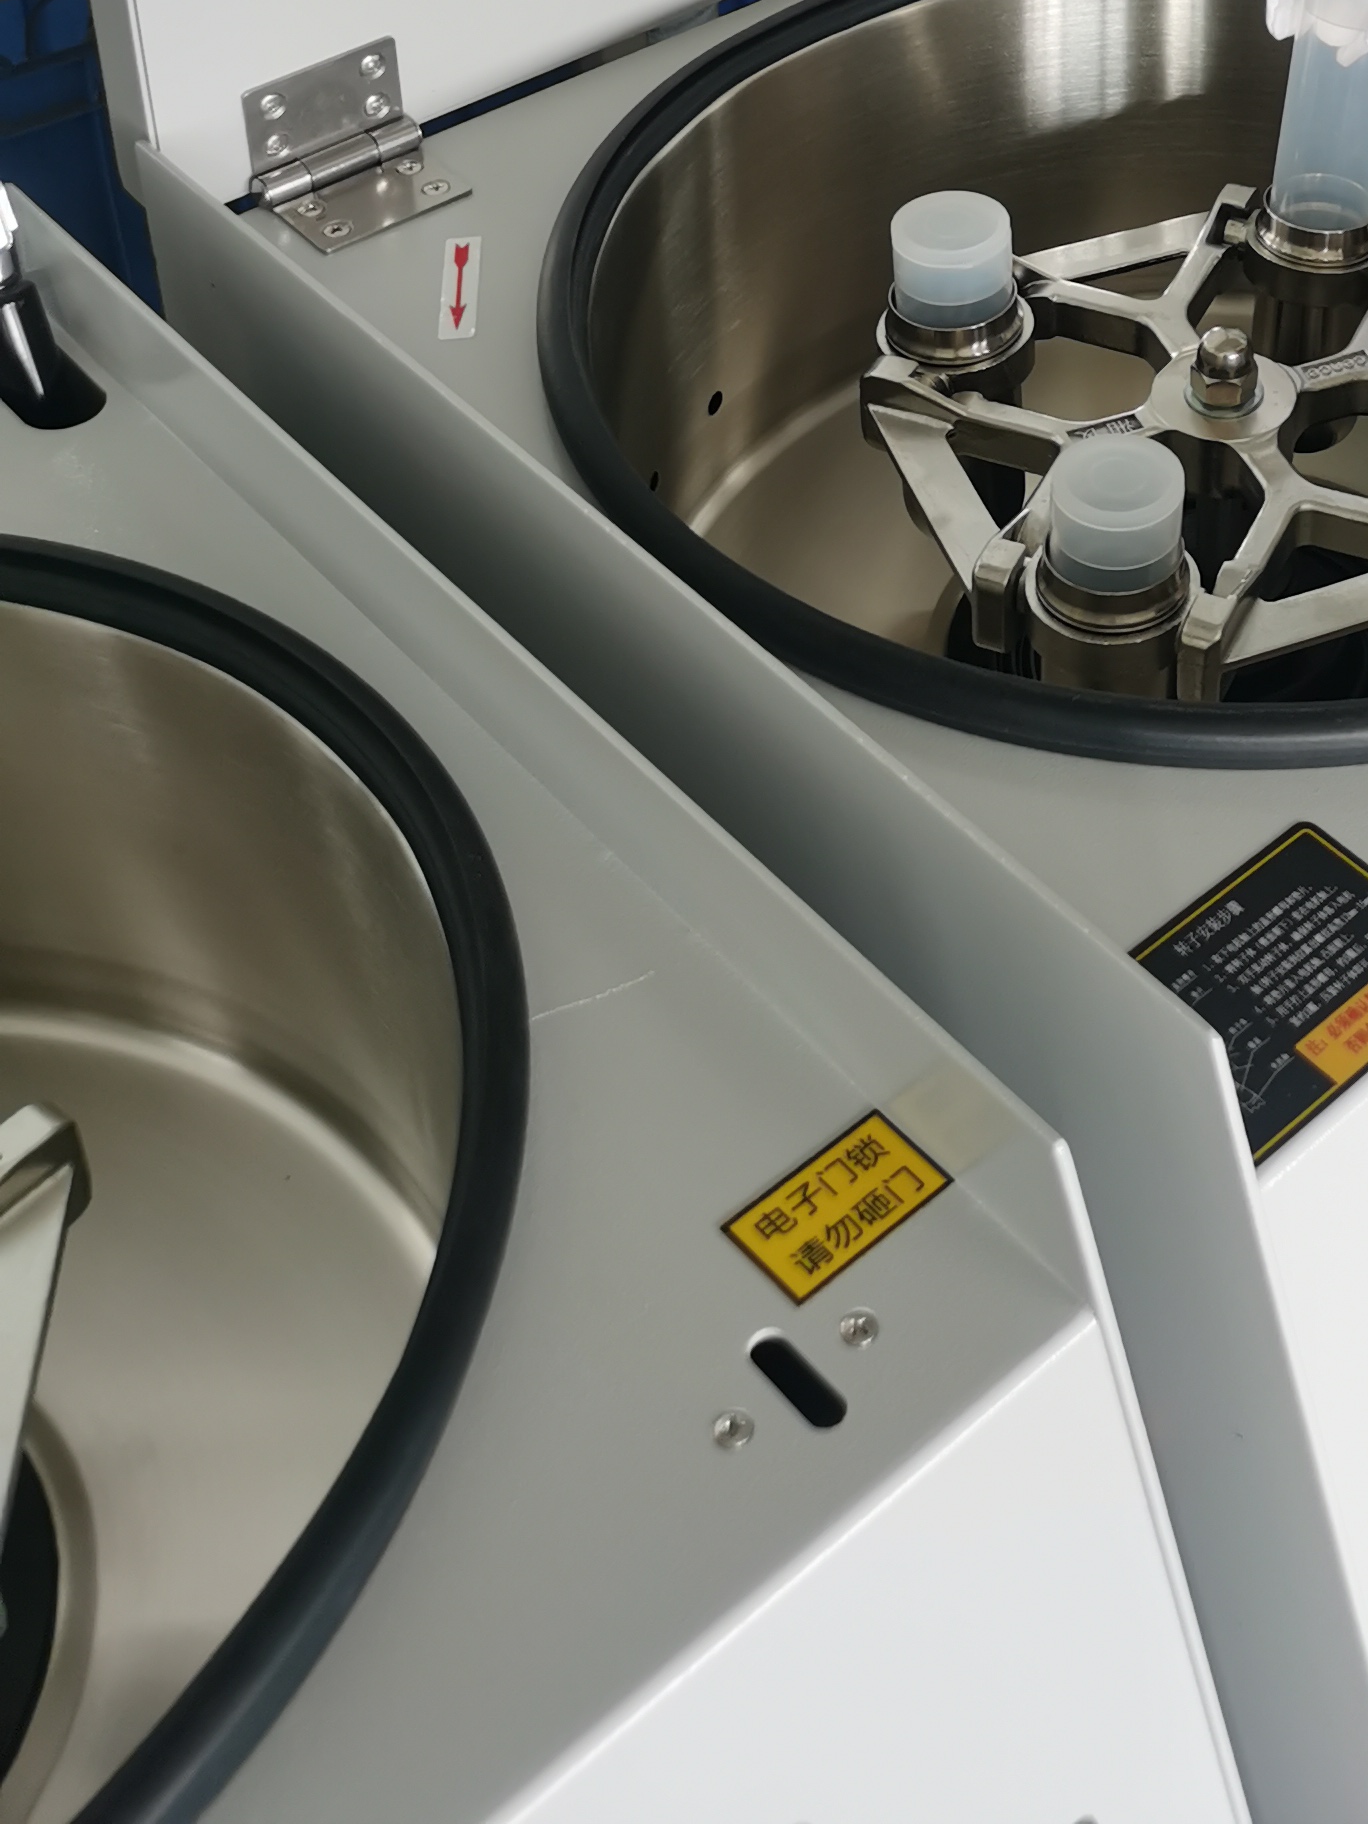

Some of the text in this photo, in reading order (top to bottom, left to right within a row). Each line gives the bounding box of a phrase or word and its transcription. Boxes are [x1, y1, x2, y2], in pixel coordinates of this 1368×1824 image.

[754, 1134, 891, 1240] 电子门锁
[790, 1165, 925, 1275] 请勿砸门
